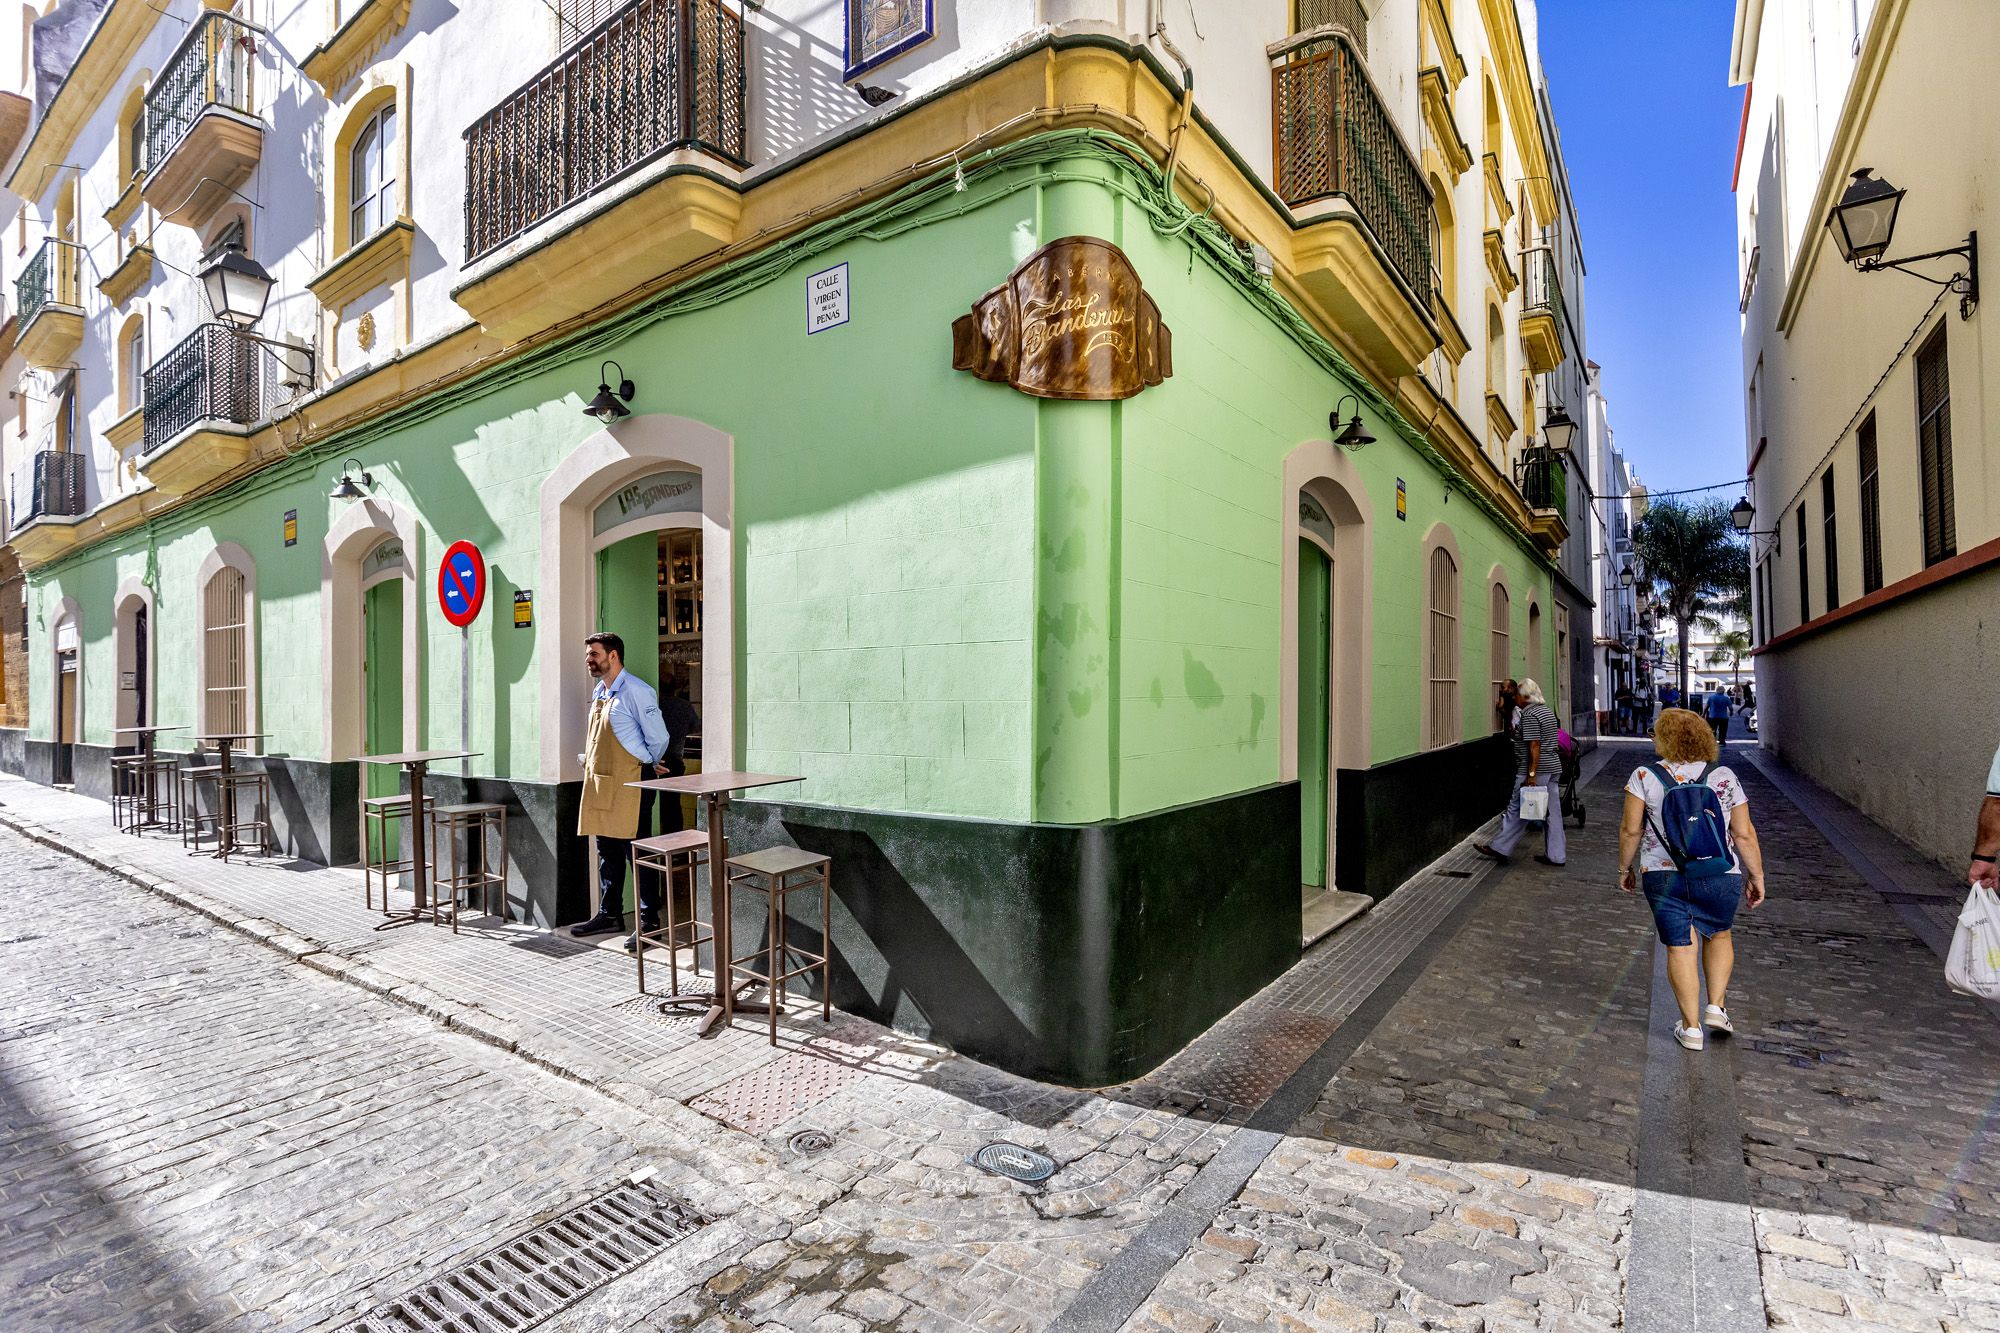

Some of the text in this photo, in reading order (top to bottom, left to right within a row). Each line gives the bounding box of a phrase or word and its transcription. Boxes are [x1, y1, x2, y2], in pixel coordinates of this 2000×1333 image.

[816, 273, 839, 290] CALLE
[814, 287, 842, 306] VIRGEN
[1034, 290, 1085, 318] Las
[816, 309, 841, 325] PENAS
[617, 480, 694, 516] LAS BANDERAS
